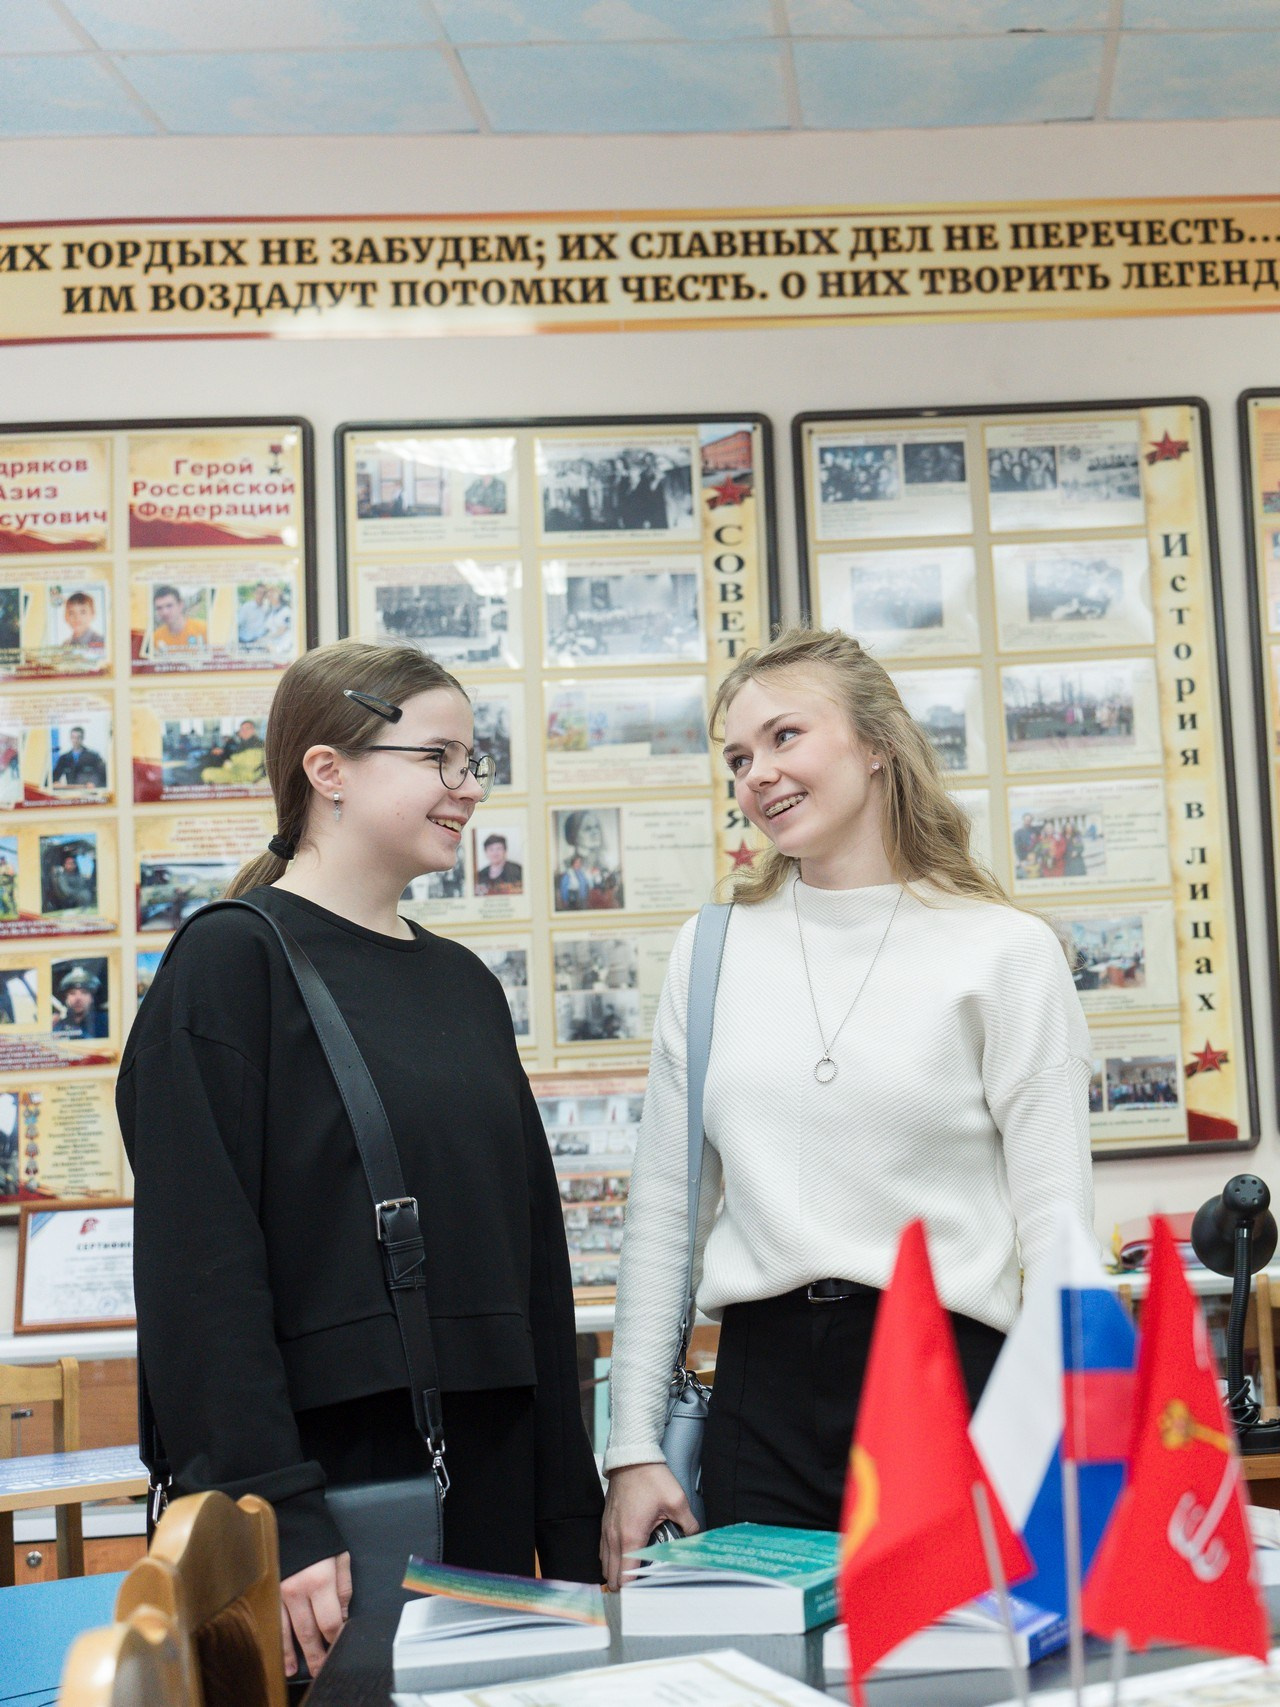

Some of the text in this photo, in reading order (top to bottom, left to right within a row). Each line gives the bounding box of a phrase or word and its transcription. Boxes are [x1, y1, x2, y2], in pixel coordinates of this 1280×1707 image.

[63, 239, 247, 275] ГОРДЫХ
[260, 238, 318, 266] НЕ
[331, 234, 546, 270] ЗАБУДЕМ;
[558, 233, 618, 261] ИХ
[629, 228, 839, 260] СЛАВНЫХ
[849, 225, 933, 262] ДЕЛ
[943, 224, 999, 252] НЕ
[63, 285, 136, 314] ИМ
[150, 281, 377, 317] ВОЗДАДУТ
[391, 276, 608, 307] ПОТОМКИ
[620, 273, 768, 303] ЧЕСТЬ.
[780, 271, 807, 299] О
[818, 268, 909, 298] НИХ
[919, 263, 1111, 295] ТВОРИТЬ
[132, 478, 296, 498] Российской
[174, 457, 254, 478] Герой
[137, 500, 291, 520] Федерации
[714, 524, 746, 660] СОВЕТ
[1160, 531, 1200, 768] История
[1185, 845, 1217, 1012] лицах
